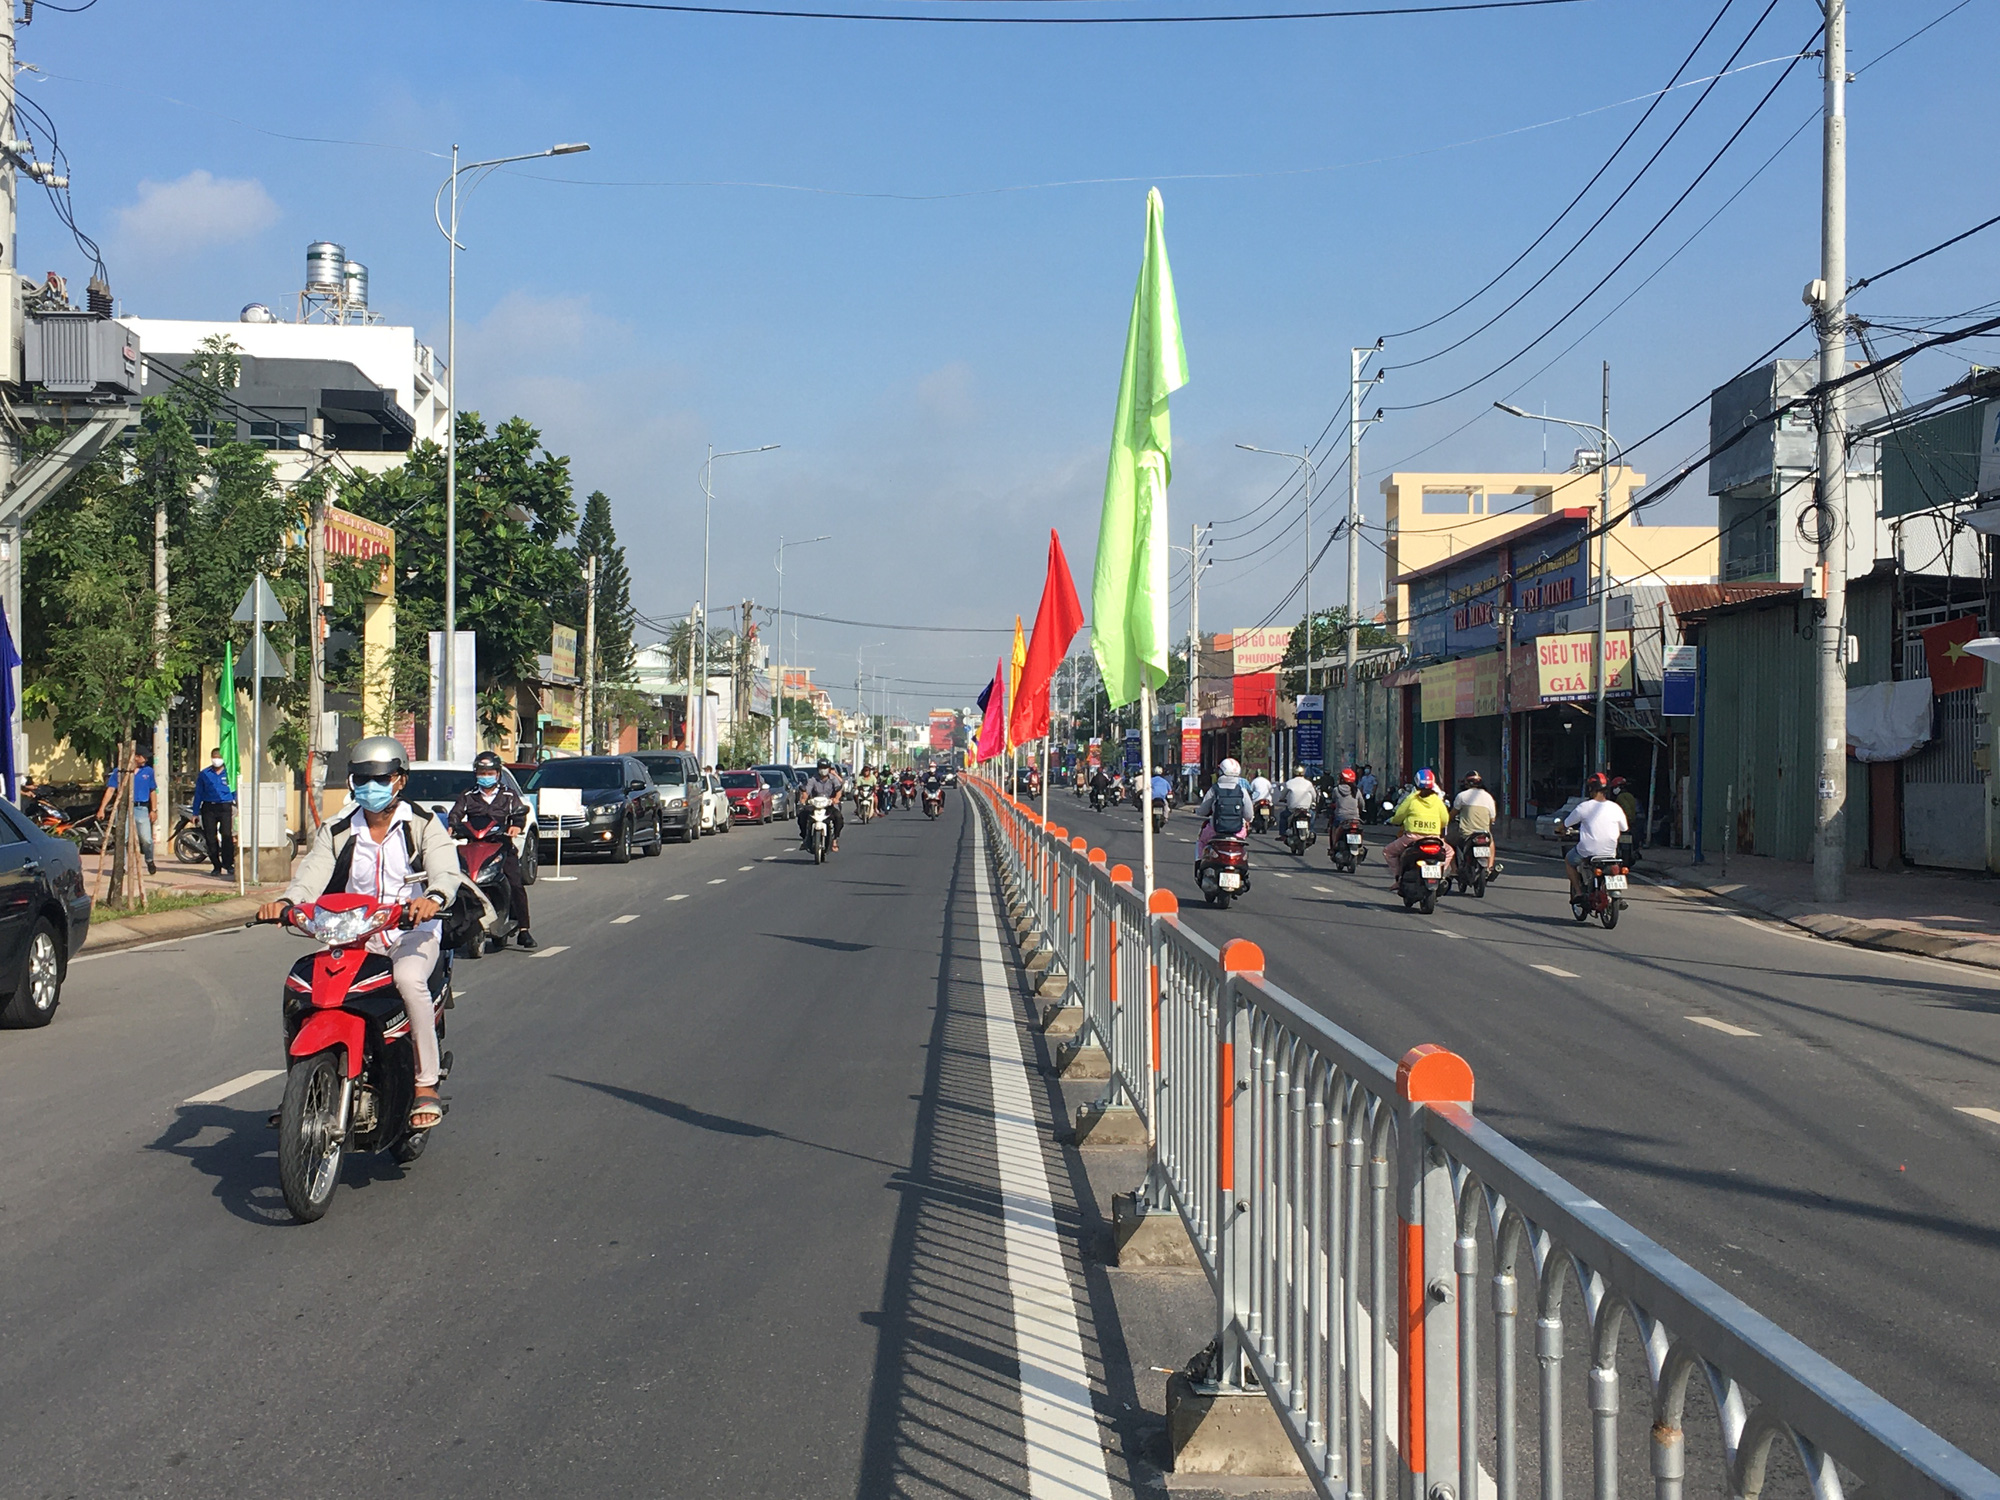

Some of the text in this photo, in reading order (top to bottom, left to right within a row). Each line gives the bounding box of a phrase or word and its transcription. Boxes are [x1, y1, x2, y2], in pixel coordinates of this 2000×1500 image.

[1542, 577, 1575, 608] MINH
[1540, 639, 1568, 666] SIÊU
[1571, 642, 1593, 667] THỊ
[1549, 672, 1587, 692] GIÁ
[385, 1010, 405, 1029] YAMAHA
